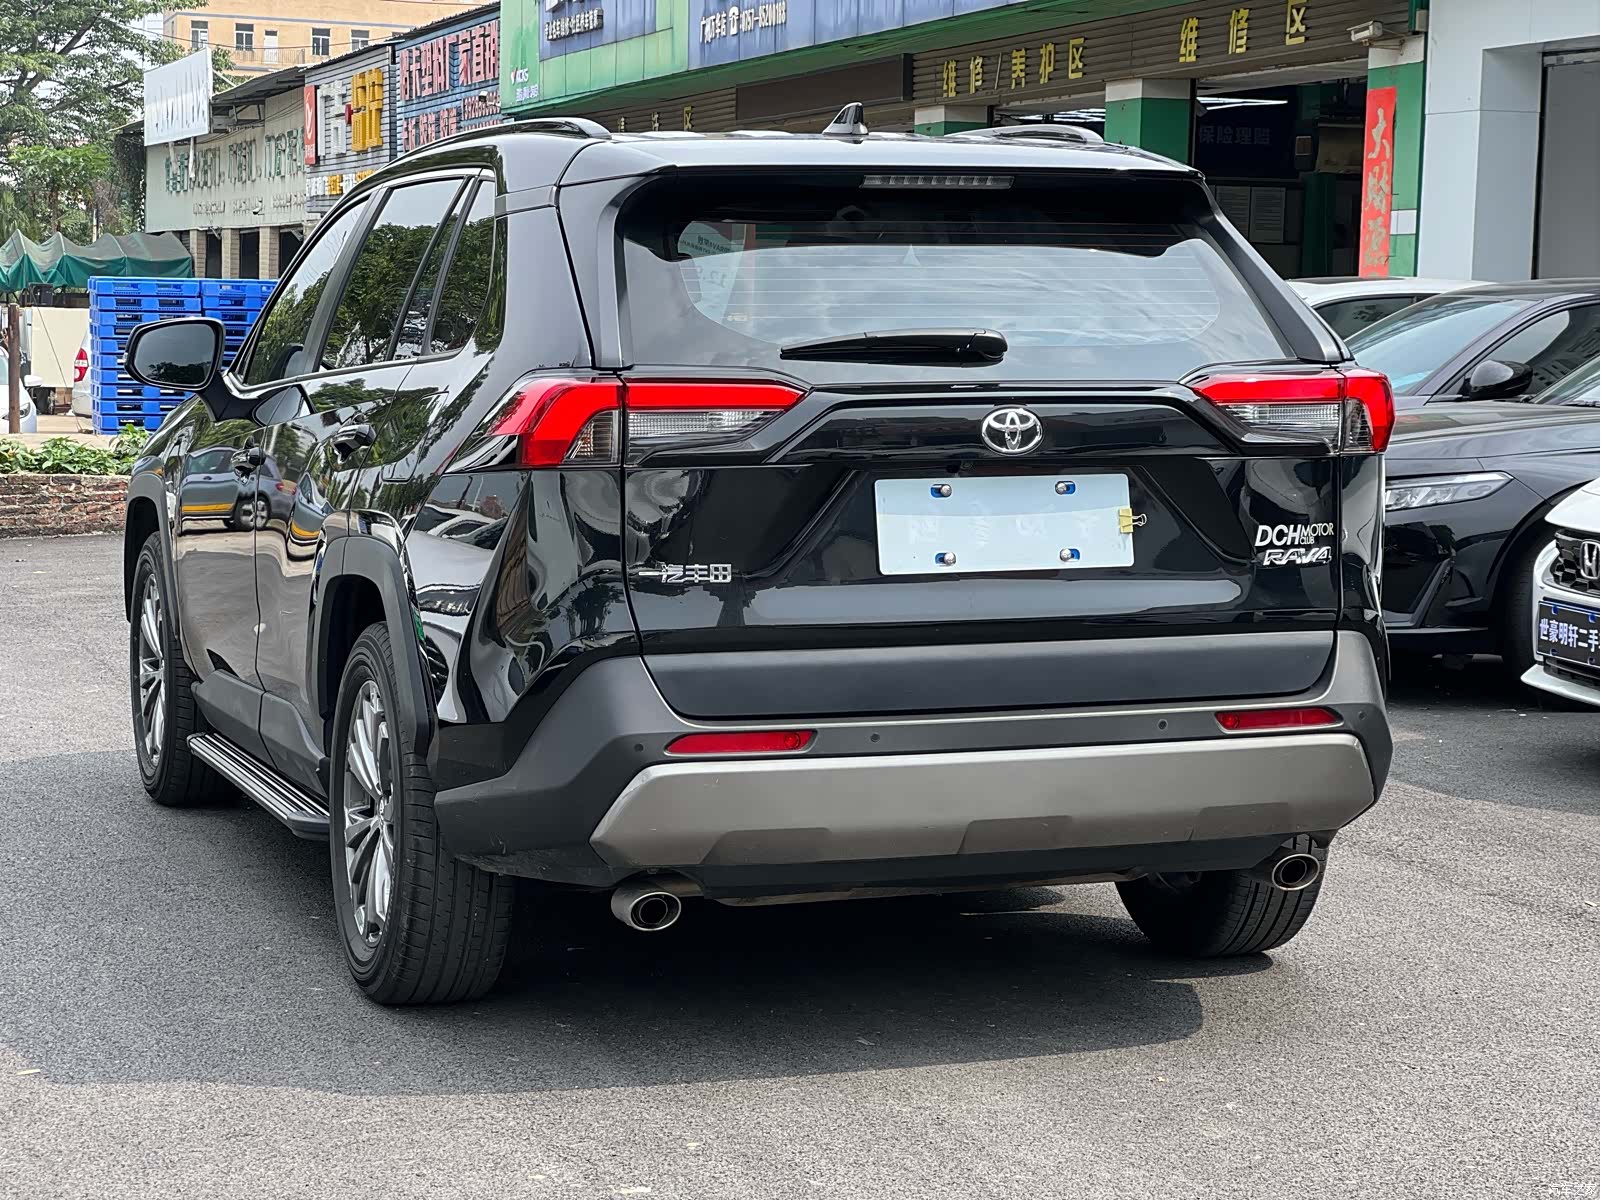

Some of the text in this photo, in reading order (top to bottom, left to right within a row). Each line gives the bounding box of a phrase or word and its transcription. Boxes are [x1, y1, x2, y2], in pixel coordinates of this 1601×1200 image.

[1179, 0, 1306, 62] 维修区
[1254, 522, 1334, 546] DCH MOTOR
[1299, 536, 1315, 545] CLUB
[1262, 546, 1333, 566] RAV4
[638, 563, 732, 584] 一汽丰田
[1539, 617, 1601, 653] 世豪明轩二手
